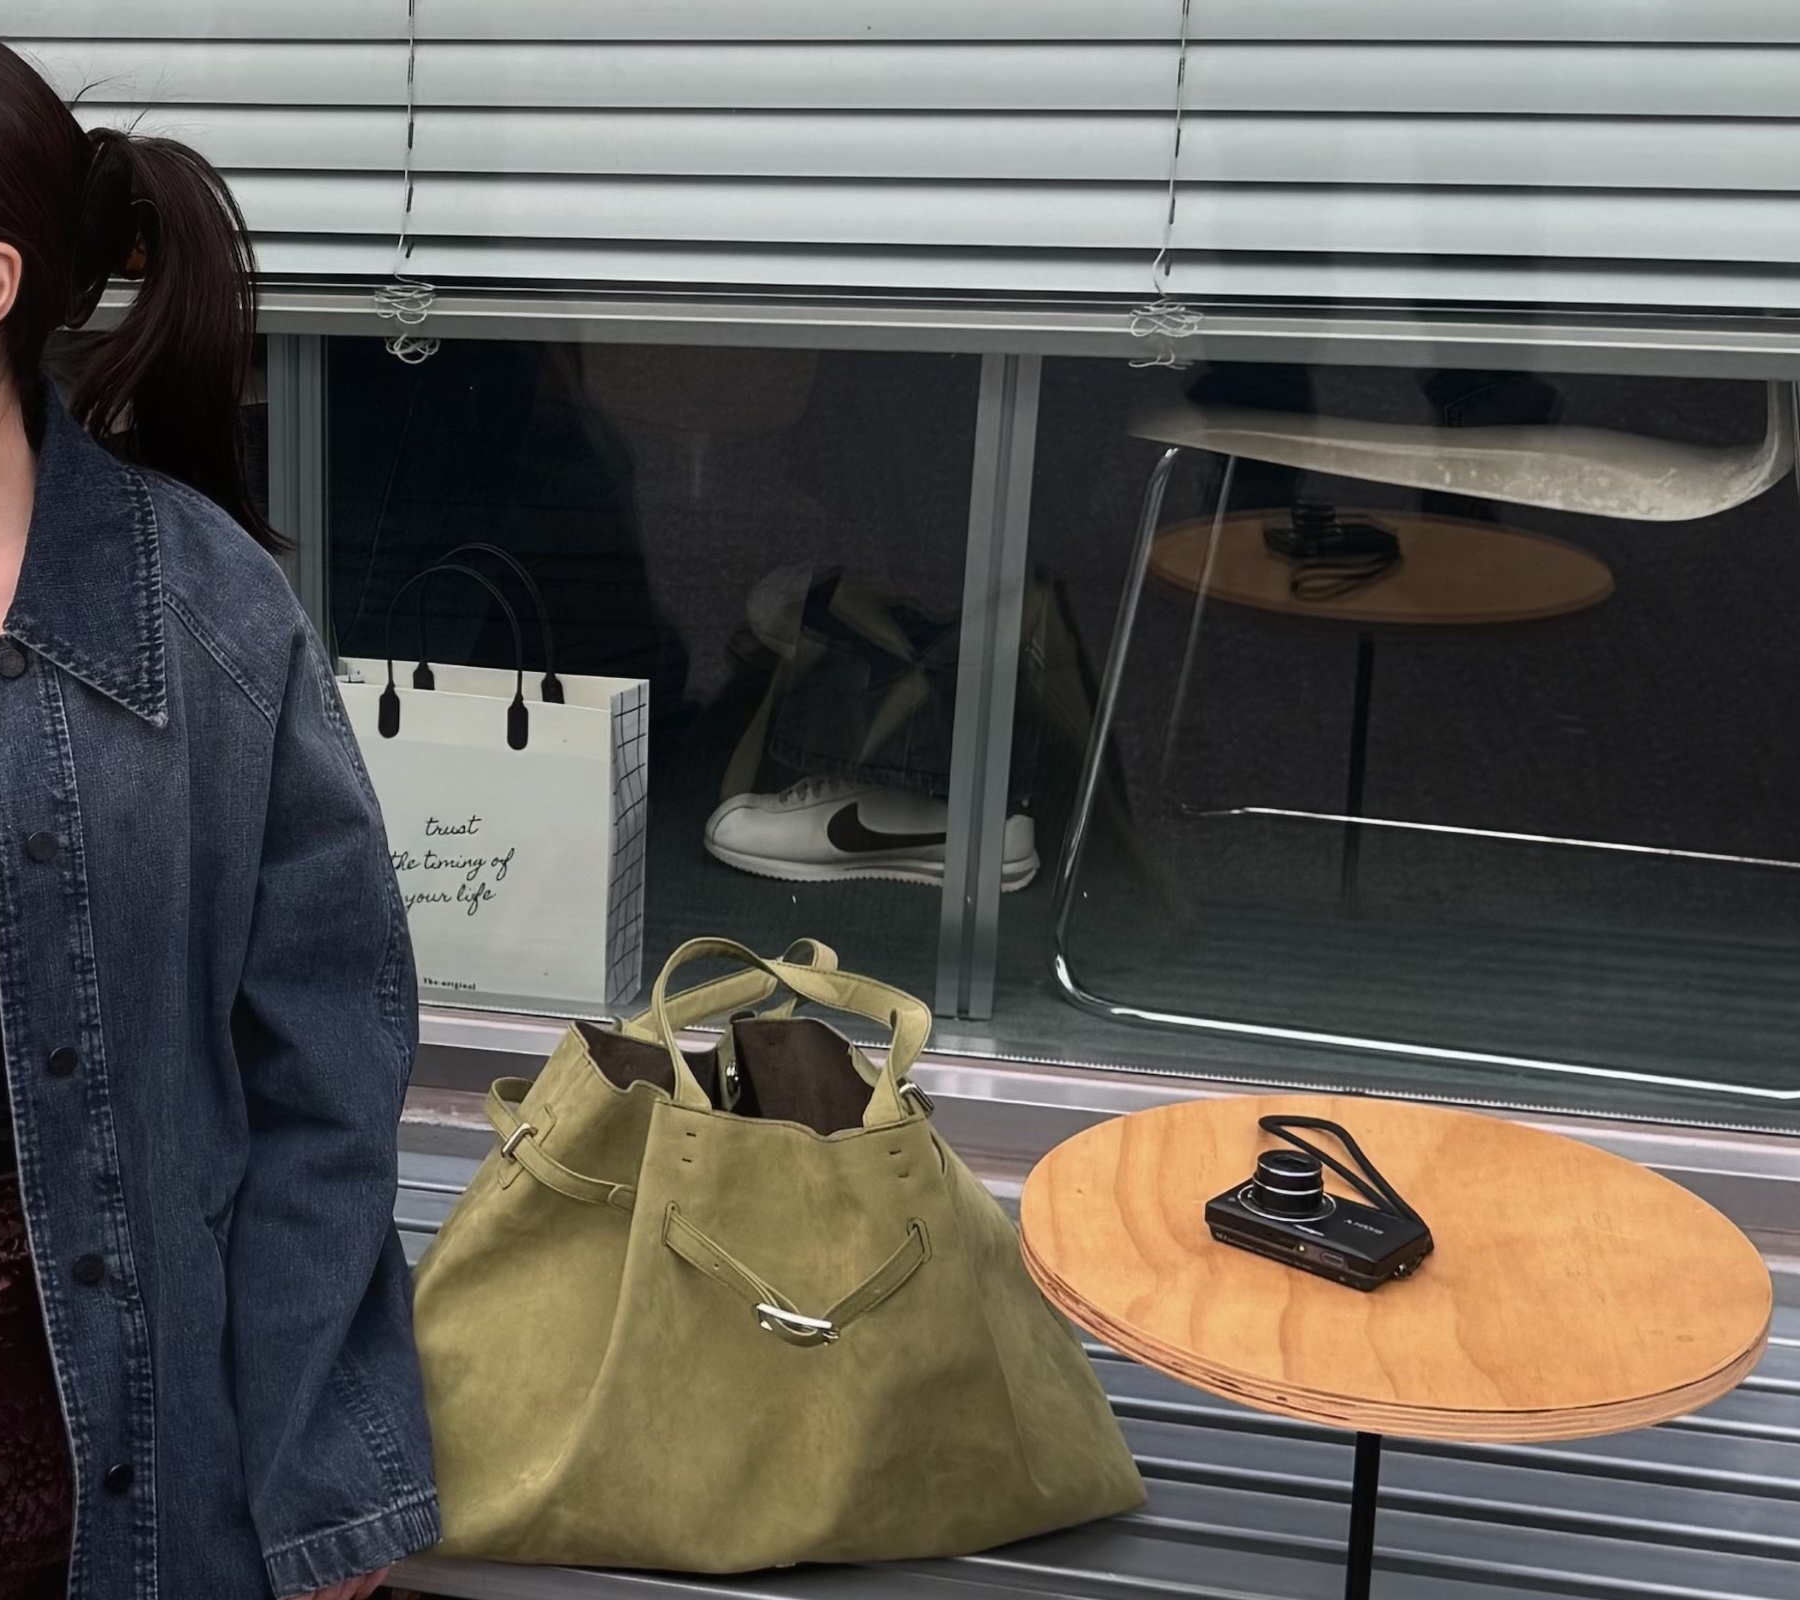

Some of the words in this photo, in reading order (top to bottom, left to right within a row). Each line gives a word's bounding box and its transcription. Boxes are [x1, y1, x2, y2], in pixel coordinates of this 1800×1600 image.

[425, 814, 482, 836] trust
[390, 850, 421, 871] the
[424, 849, 487, 882] timing
[490, 847, 515, 882] of
[404, 891, 452, 915] your
[456, 882, 497, 917] life
[441, 980, 477, 991] original
